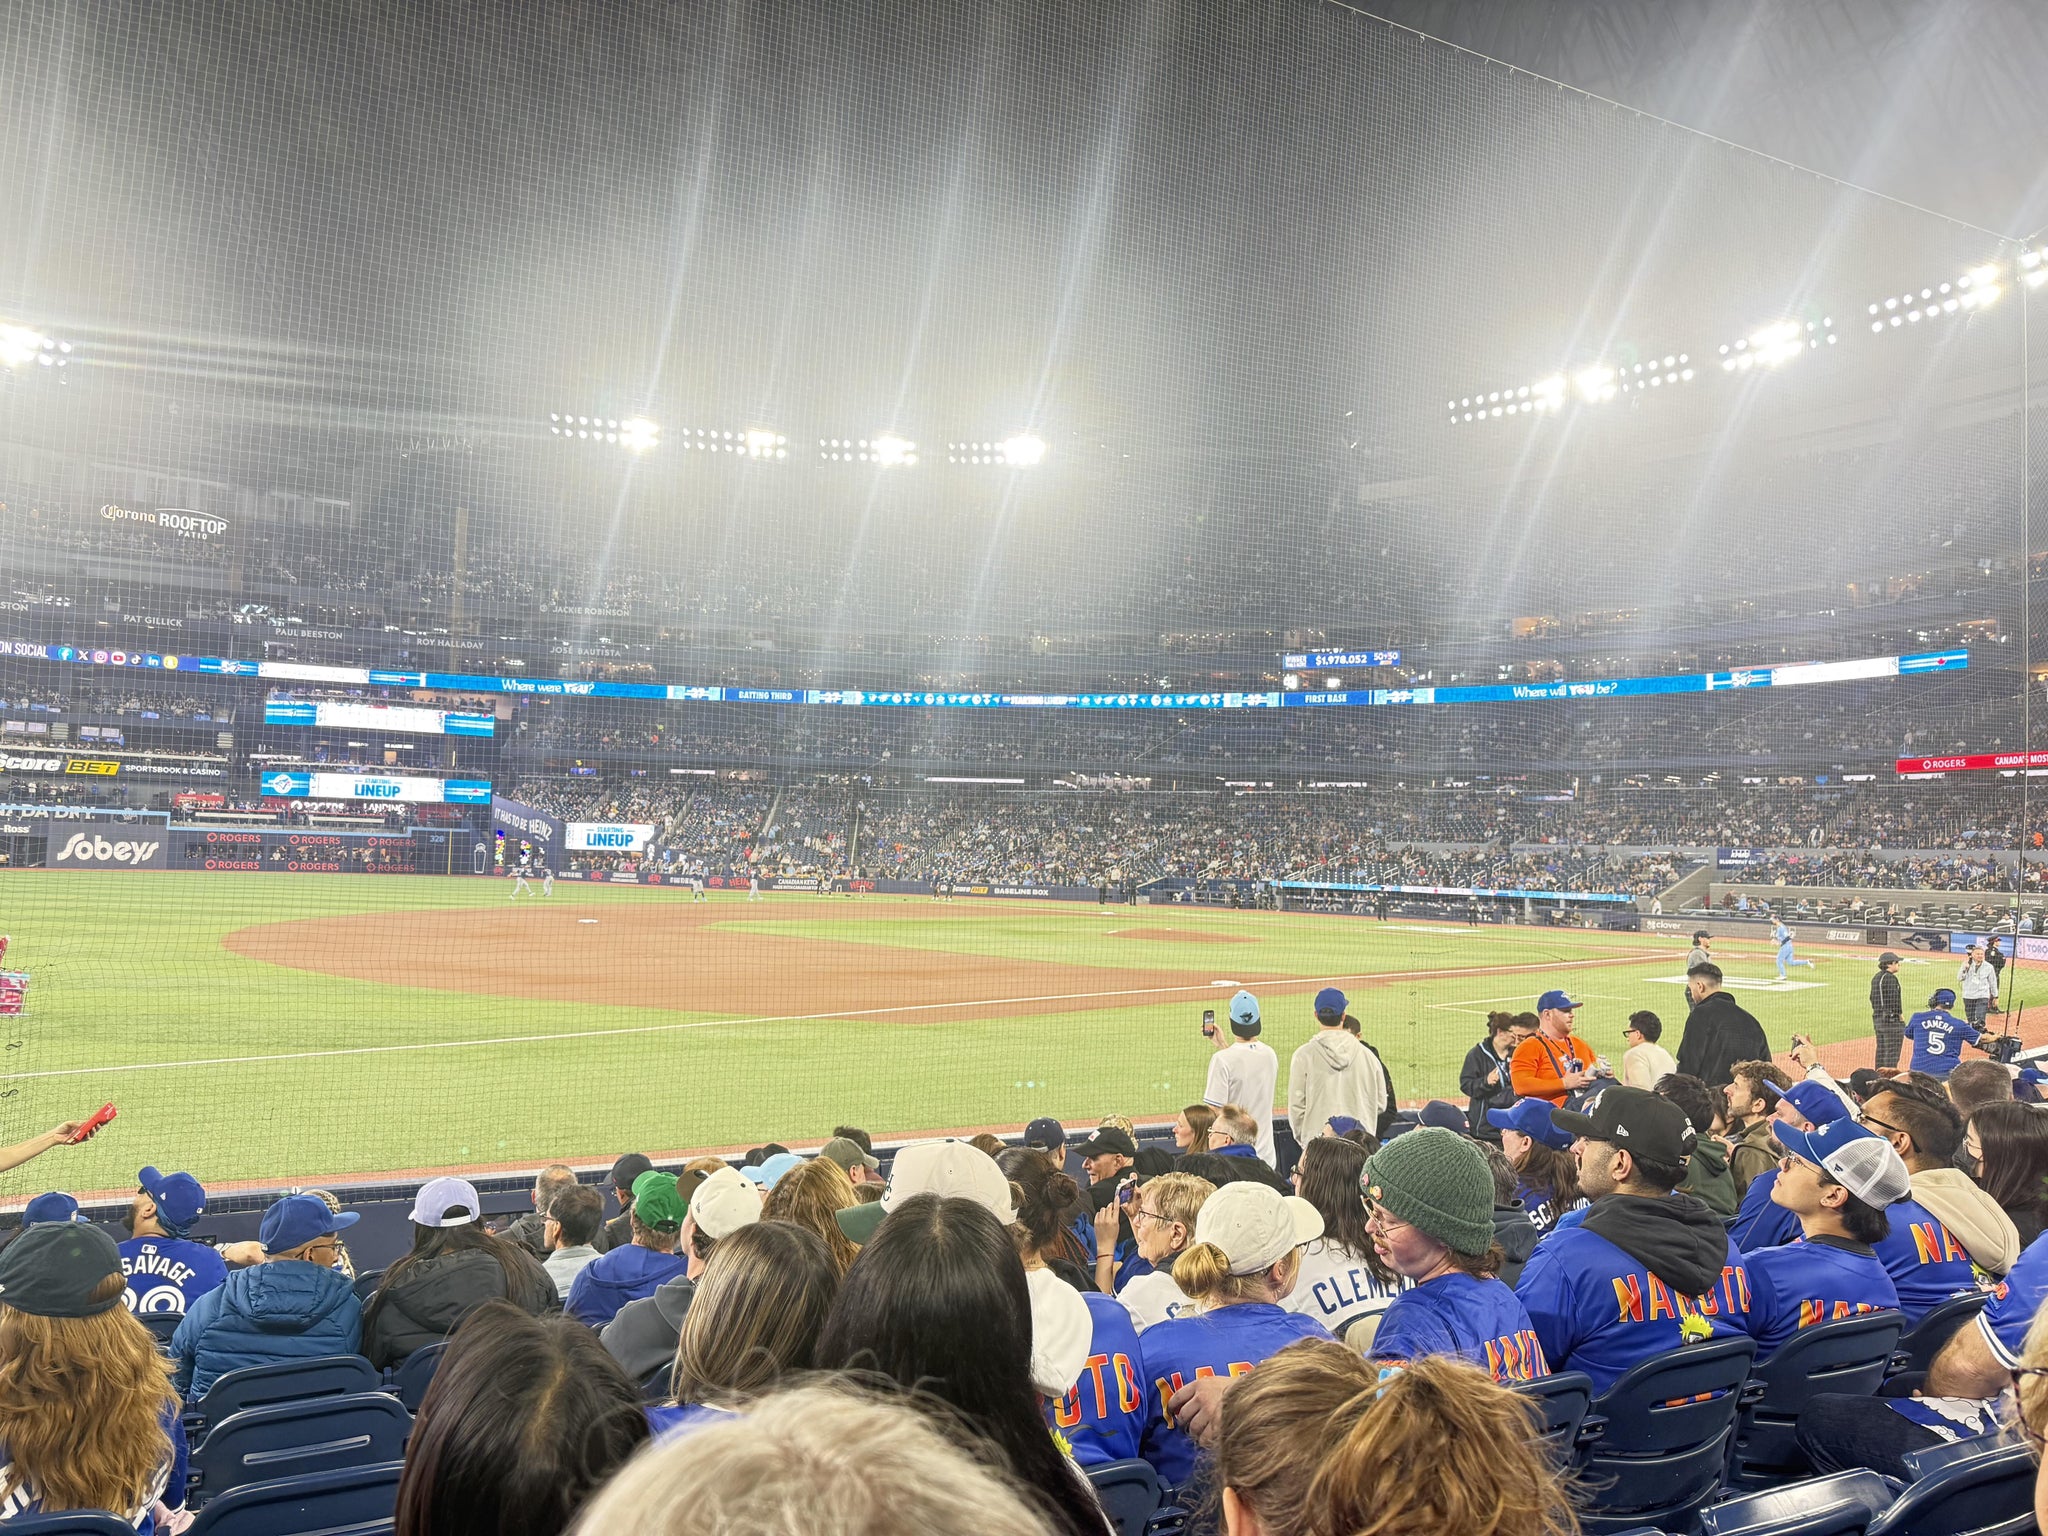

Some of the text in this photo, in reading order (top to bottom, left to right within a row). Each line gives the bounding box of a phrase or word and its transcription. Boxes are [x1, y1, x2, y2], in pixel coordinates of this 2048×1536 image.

[100, 504, 227, 535] Corona ROOFTOP
[178, 530, 208, 540] PATIO
[552, 606, 583, 615] JACKIE
[584, 607, 630, 617] ROBINSON
[124, 615, 183, 627] PAT GILLICK
[275, 628, 343, 640] PAUL BEESTON
[417, 638, 435, 647] ROY
[438, 639, 485, 649] HALLADAY
[14, 643, 49, 658] SOCIAL
[577, 647, 621, 657] BAUTISTA
[501, 678, 535, 692] Where
[537, 683, 562, 693] were
[1513, 686, 1547, 698] Where
[1549, 685, 1567, 697] will
[1597, 682, 1618, 694] be?
[738, 690, 793, 701] BATTING THIRD
[1305, 694, 1347, 703] FIRST BASE
[69, 762, 118, 773] BET
[125, 765, 181, 774] SPORTSBOOK
[190, 768, 221, 776] CASINO
[1932, 758, 1966, 769] ROGERS
[354, 784, 401, 798] LINEUP
[500, 809, 512, 825] HAS
[511, 814, 520, 828] TO
[519, 817, 528, 831] BE
[529, 818, 553, 842] HEINZ
[219, 833, 261, 843] ROGERS
[301, 836, 341, 846] ROGERS
[379, 837, 417, 848] ROGERS
[429, 835, 445, 843] 328
[586, 833, 634, 847] LINEUP
[57, 833, 160, 865] Sobeys
[218, 861, 260, 870] ROGERS
[300, 862, 340, 872] ROGERS
[378, 864, 415, 873] ROGERS
[729, 877, 749, 887] HEIN
[994, 887, 1031, 896] BASELINE
[1032, 888, 1049, 896] BOX
[1656, 921, 1681, 930] clover
[1921, 1019, 1954, 1034] CAMERA
[1926, 1031, 1946, 1055] 5
[120, 1254, 196, 1287] SAVAGE
